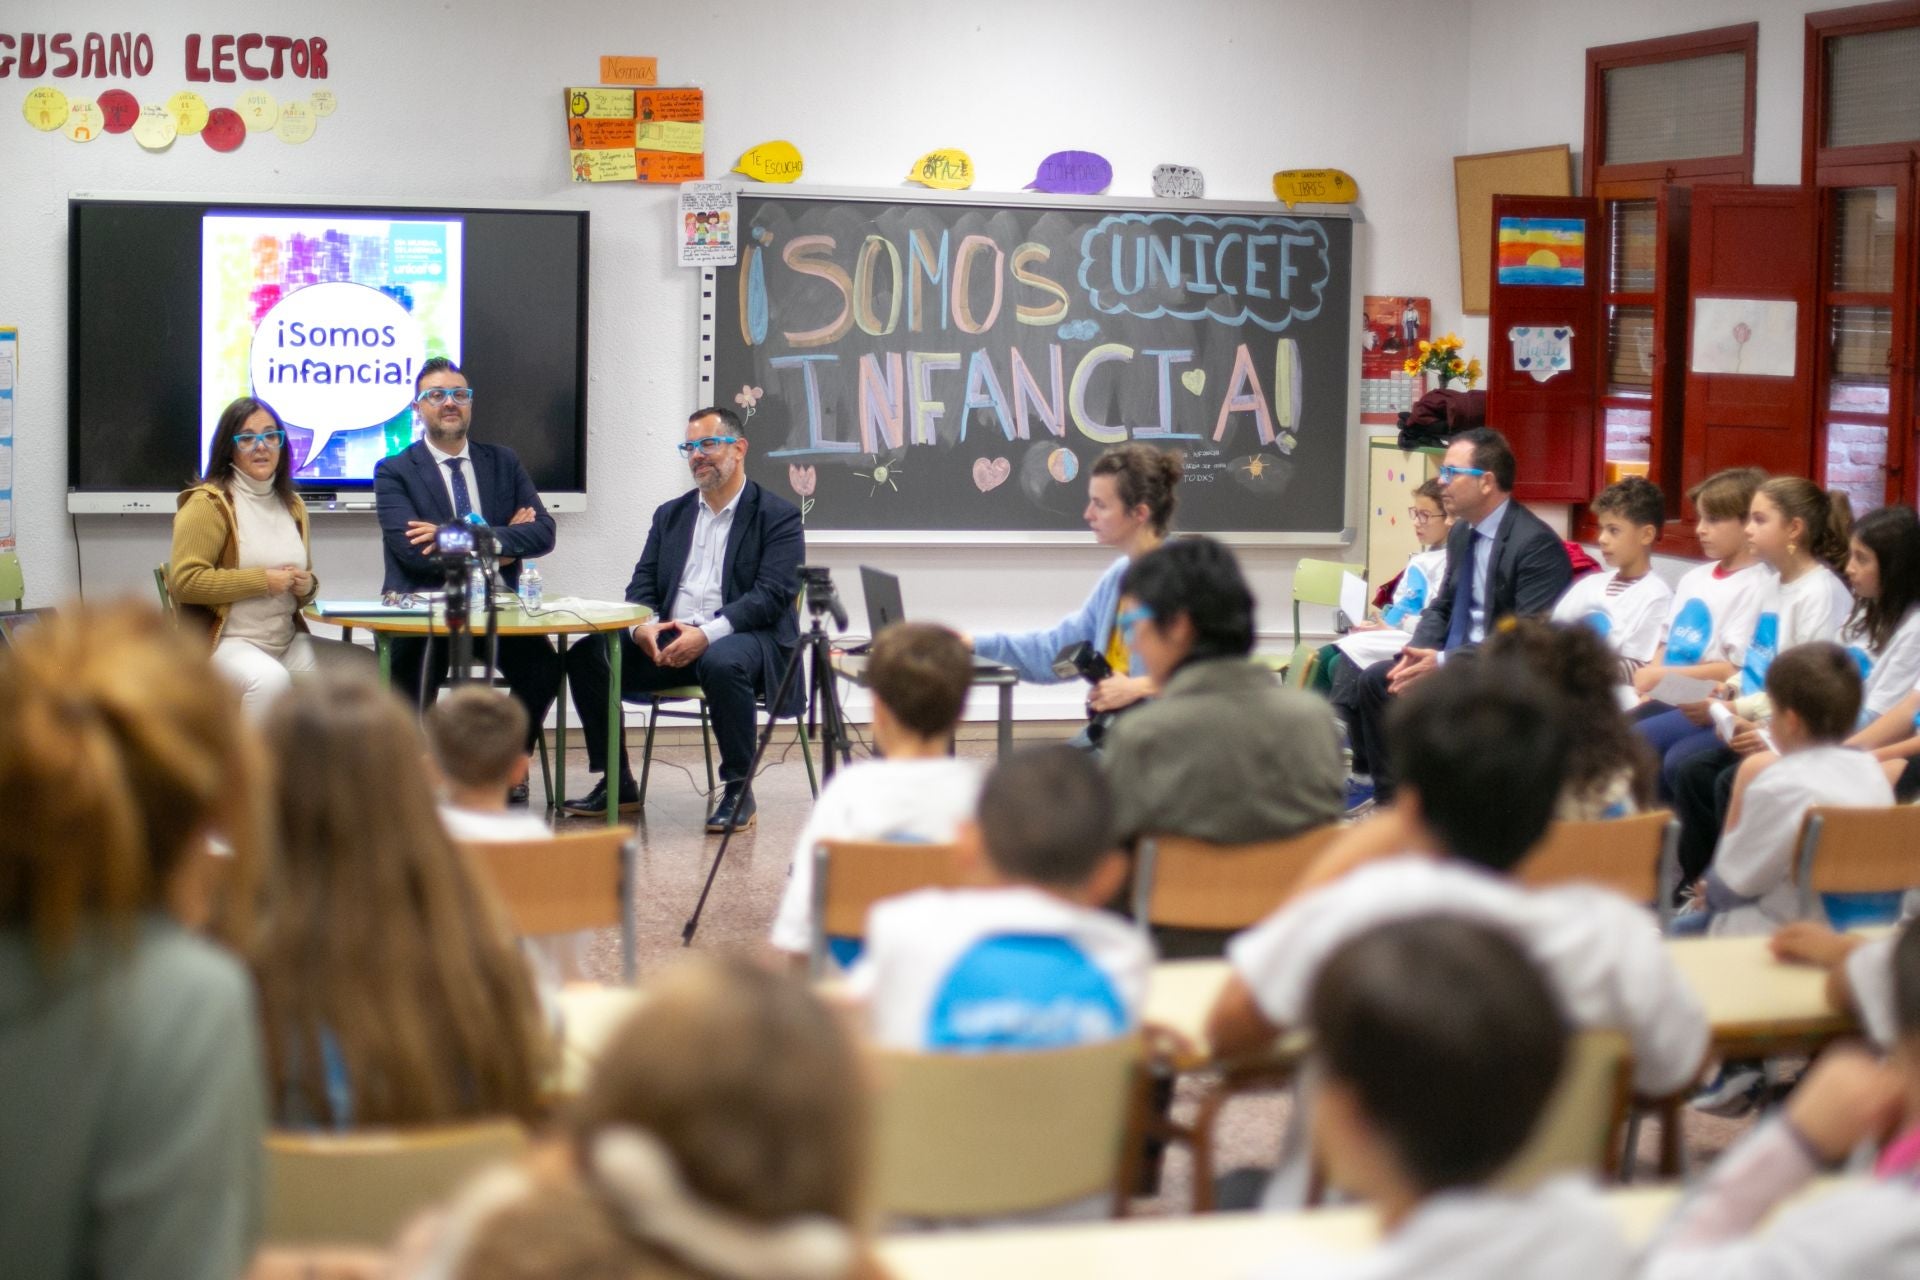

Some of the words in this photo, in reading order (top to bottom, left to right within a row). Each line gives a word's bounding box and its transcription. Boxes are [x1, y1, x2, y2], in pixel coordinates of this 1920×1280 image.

[0, 31, 154, 79] GUSANO
[184, 33, 328, 83] LECTOR
[607, 56, 655, 81] Normas
[750, 150, 761, 166] TE
[765, 159, 803, 175] ESCUCHO
[934, 160, 962, 180] PAZ
[1291, 181, 1326, 197] LIBRES
[1111, 232, 1315, 300] UNICEF
[277, 320, 396, 347] ¡Somos
[268, 357, 412, 385] infancia!
[767, 337, 1302, 458] INFANCIA!
[1184, 474, 1214, 483] TODXS
